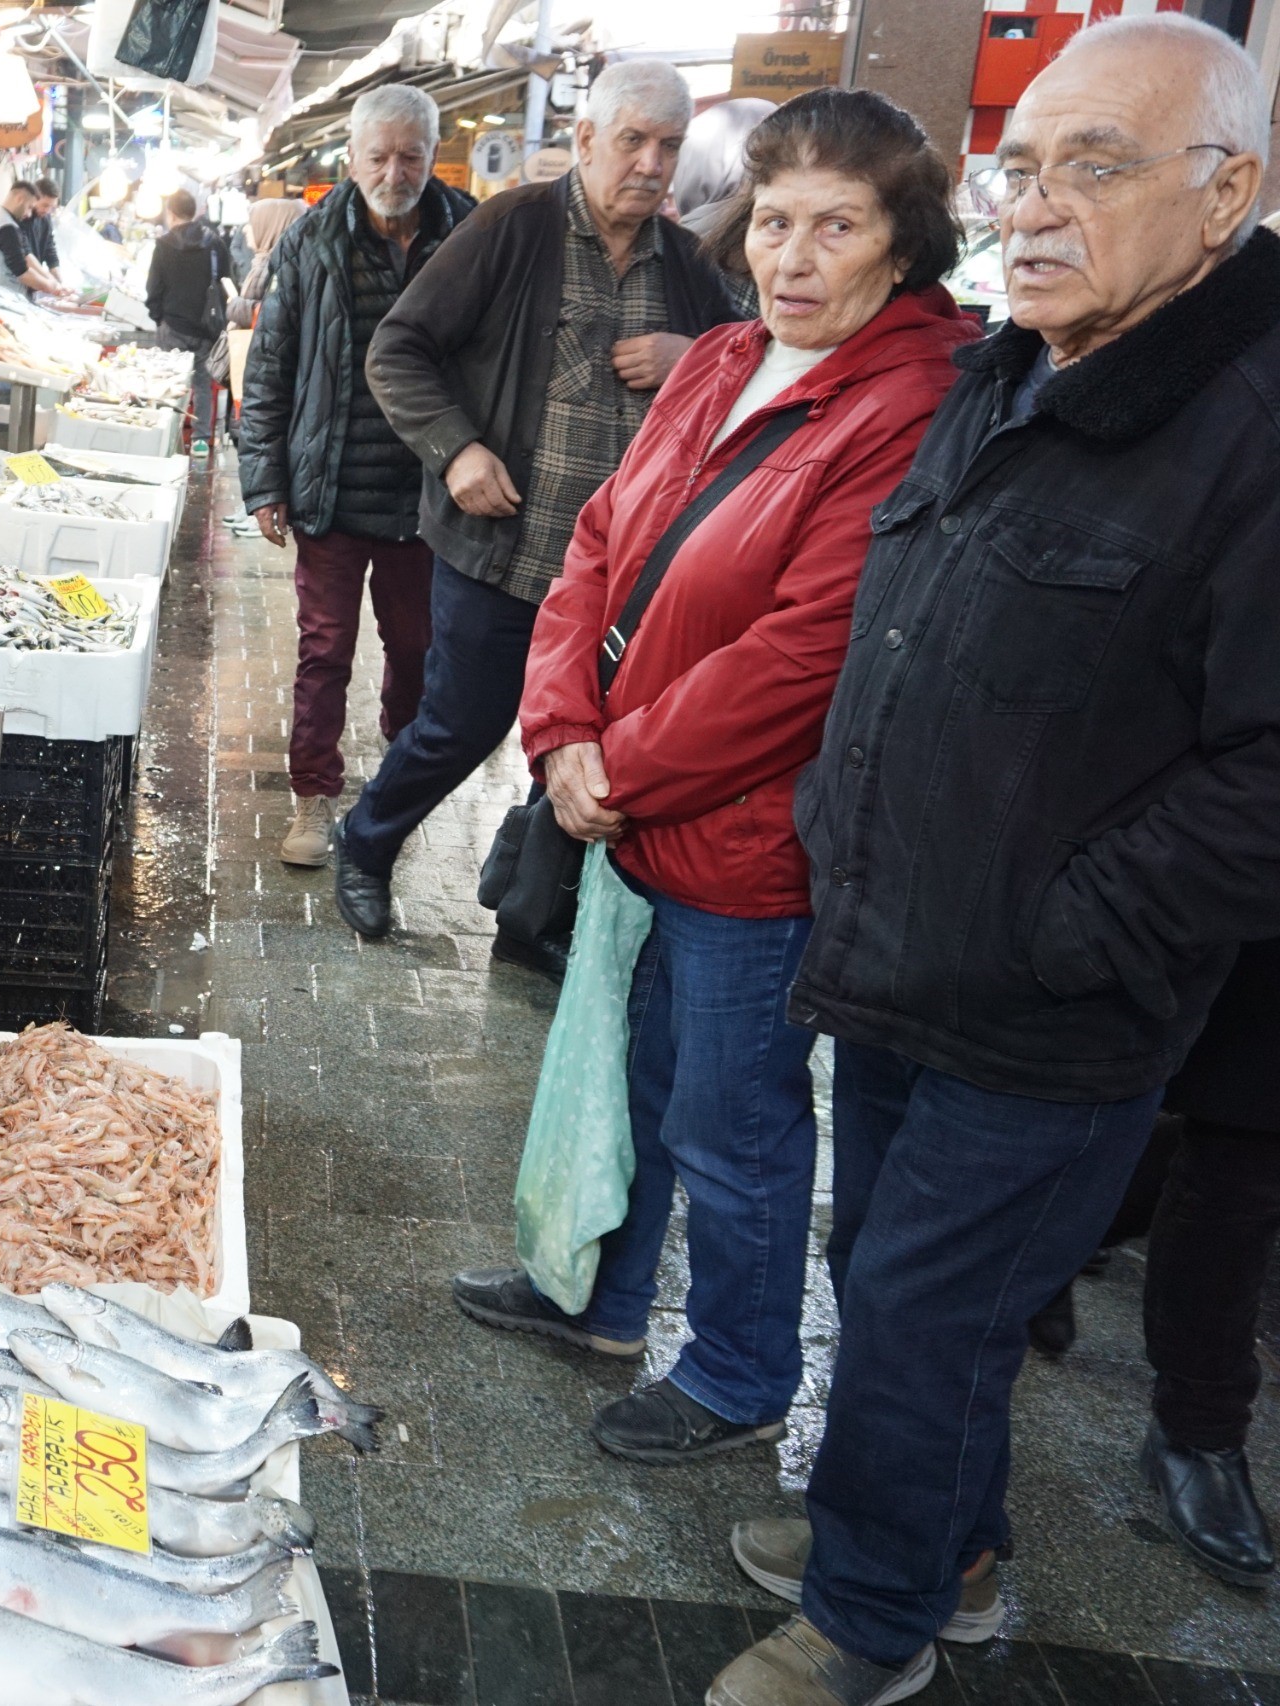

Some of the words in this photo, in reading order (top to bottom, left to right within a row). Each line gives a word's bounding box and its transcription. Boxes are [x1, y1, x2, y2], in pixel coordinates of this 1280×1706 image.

[762, 47, 810, 66] Örnek
[45, 1416, 72, 1500] ALABALIK
[69, 1430, 146, 1513] 250
